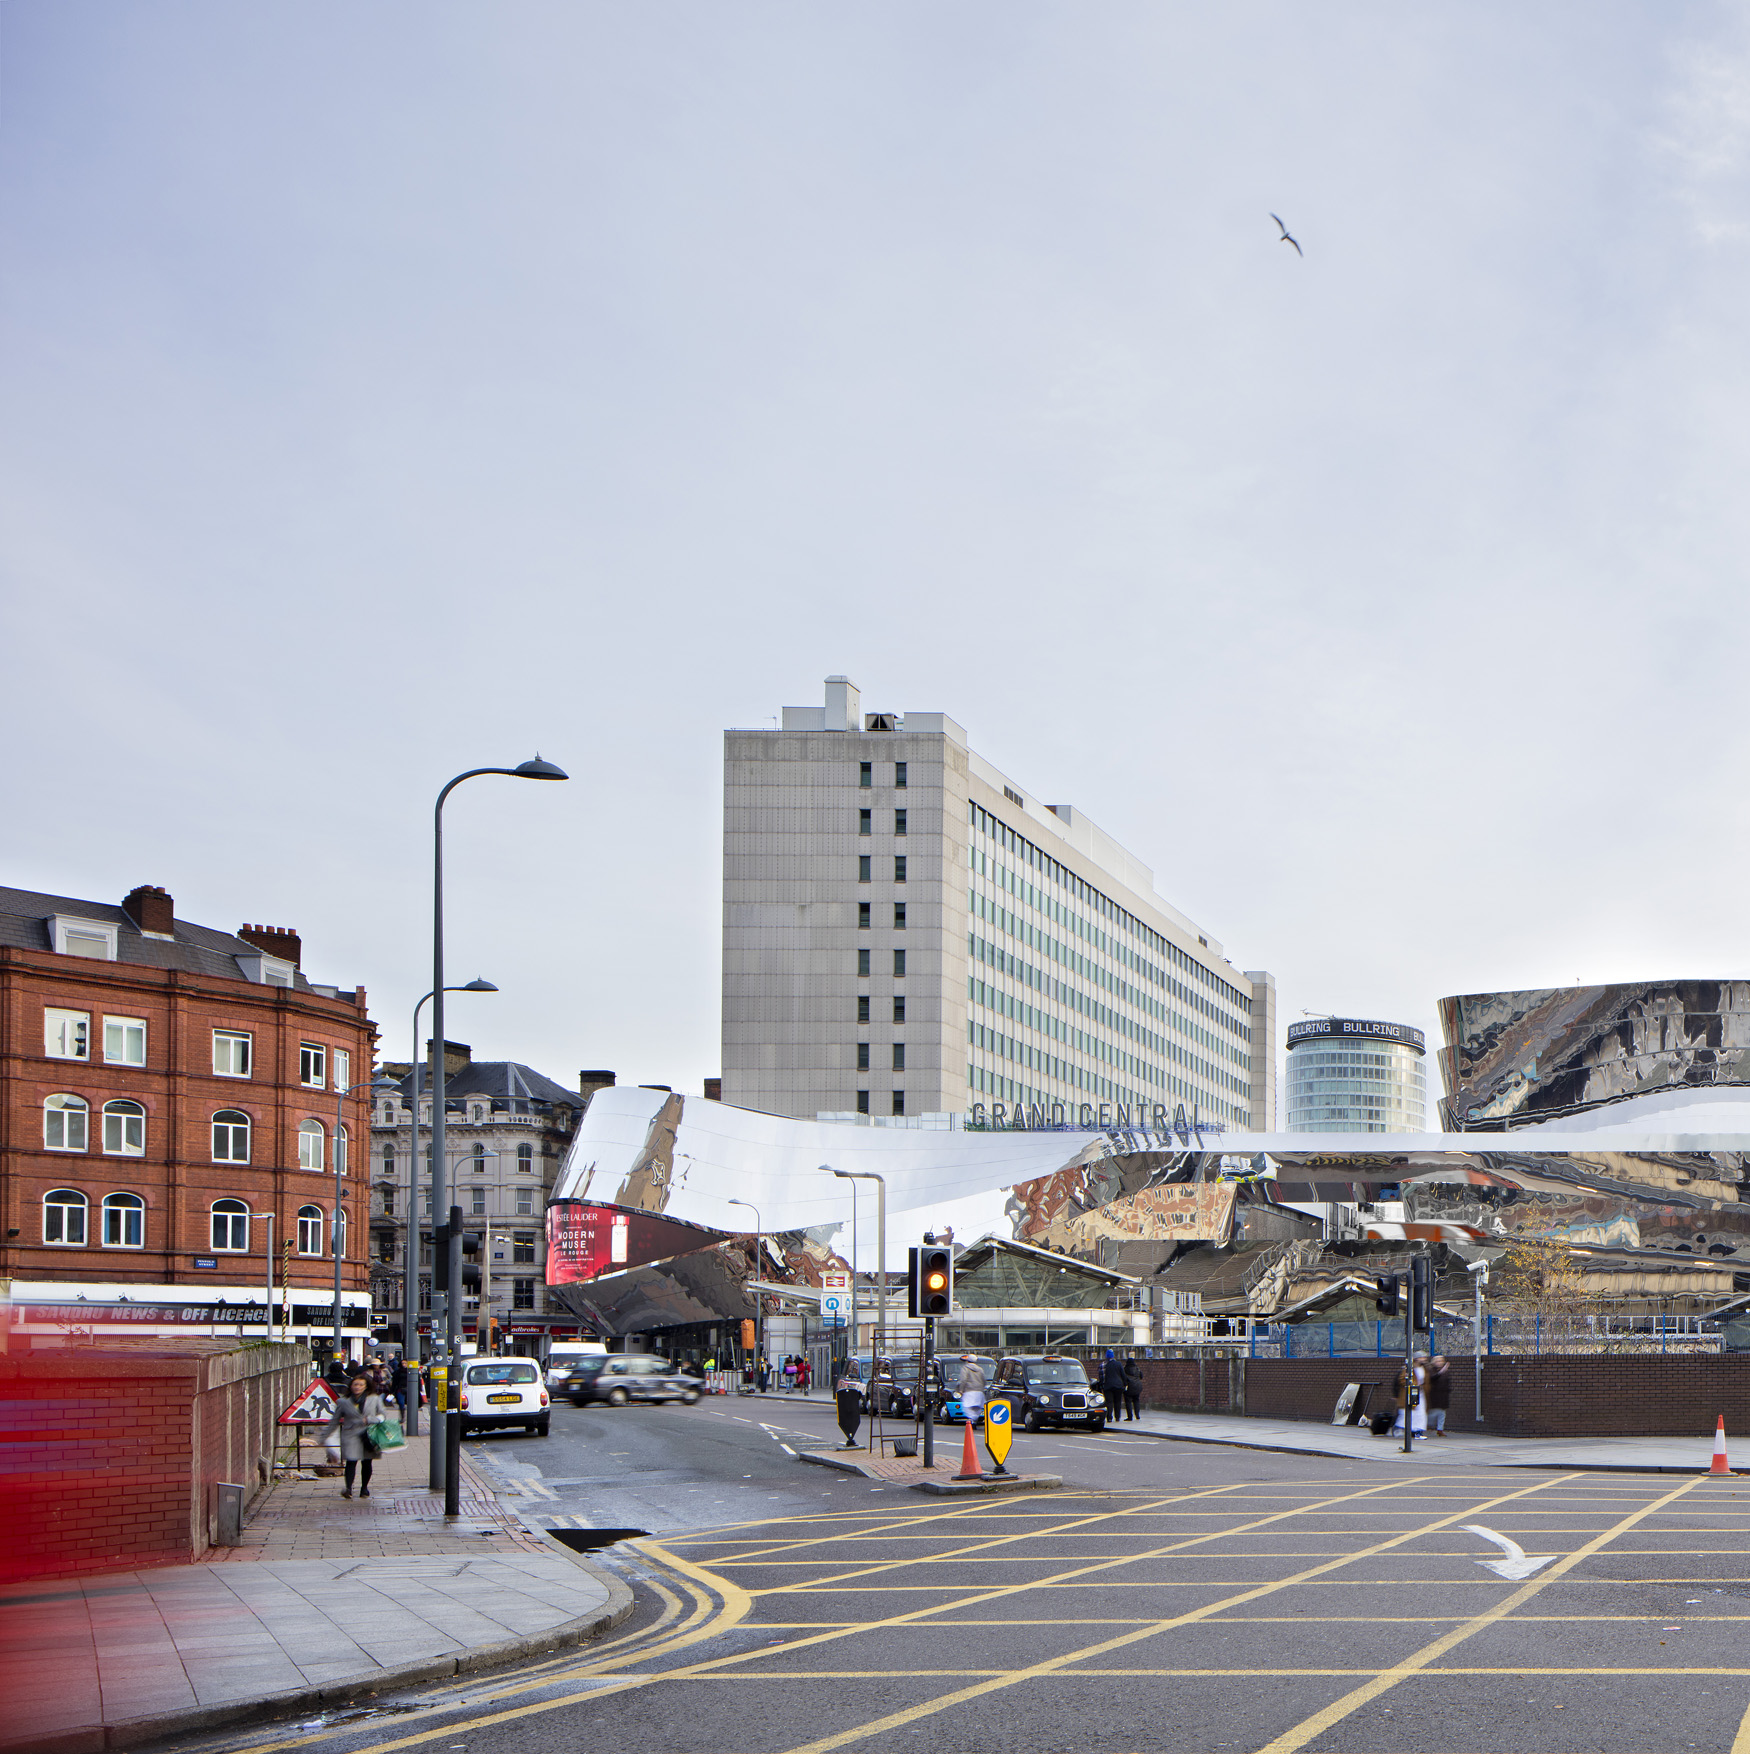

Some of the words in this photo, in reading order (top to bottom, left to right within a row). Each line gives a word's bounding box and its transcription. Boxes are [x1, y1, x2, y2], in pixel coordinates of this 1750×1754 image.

[1290, 1023, 1331, 1037] BULLRING
[1343, 1022, 1400, 1037] BULLRING
[972, 1102, 1067, 1129] GRAND
[1079, 1102, 1204, 1129] CENTRAL
[570, 1213, 598, 1221] LAUDER
[558, 1231, 595, 1239] MODERN
[562, 1240, 587, 1249] MUSE
[36, 1306, 104, 1320] SANDHU
[111, 1307, 158, 1320] NEWS
[163, 1309, 175, 1321] &
[181, 1308, 208, 1321] OFF
[313, 1317, 324, 1325] OFF
